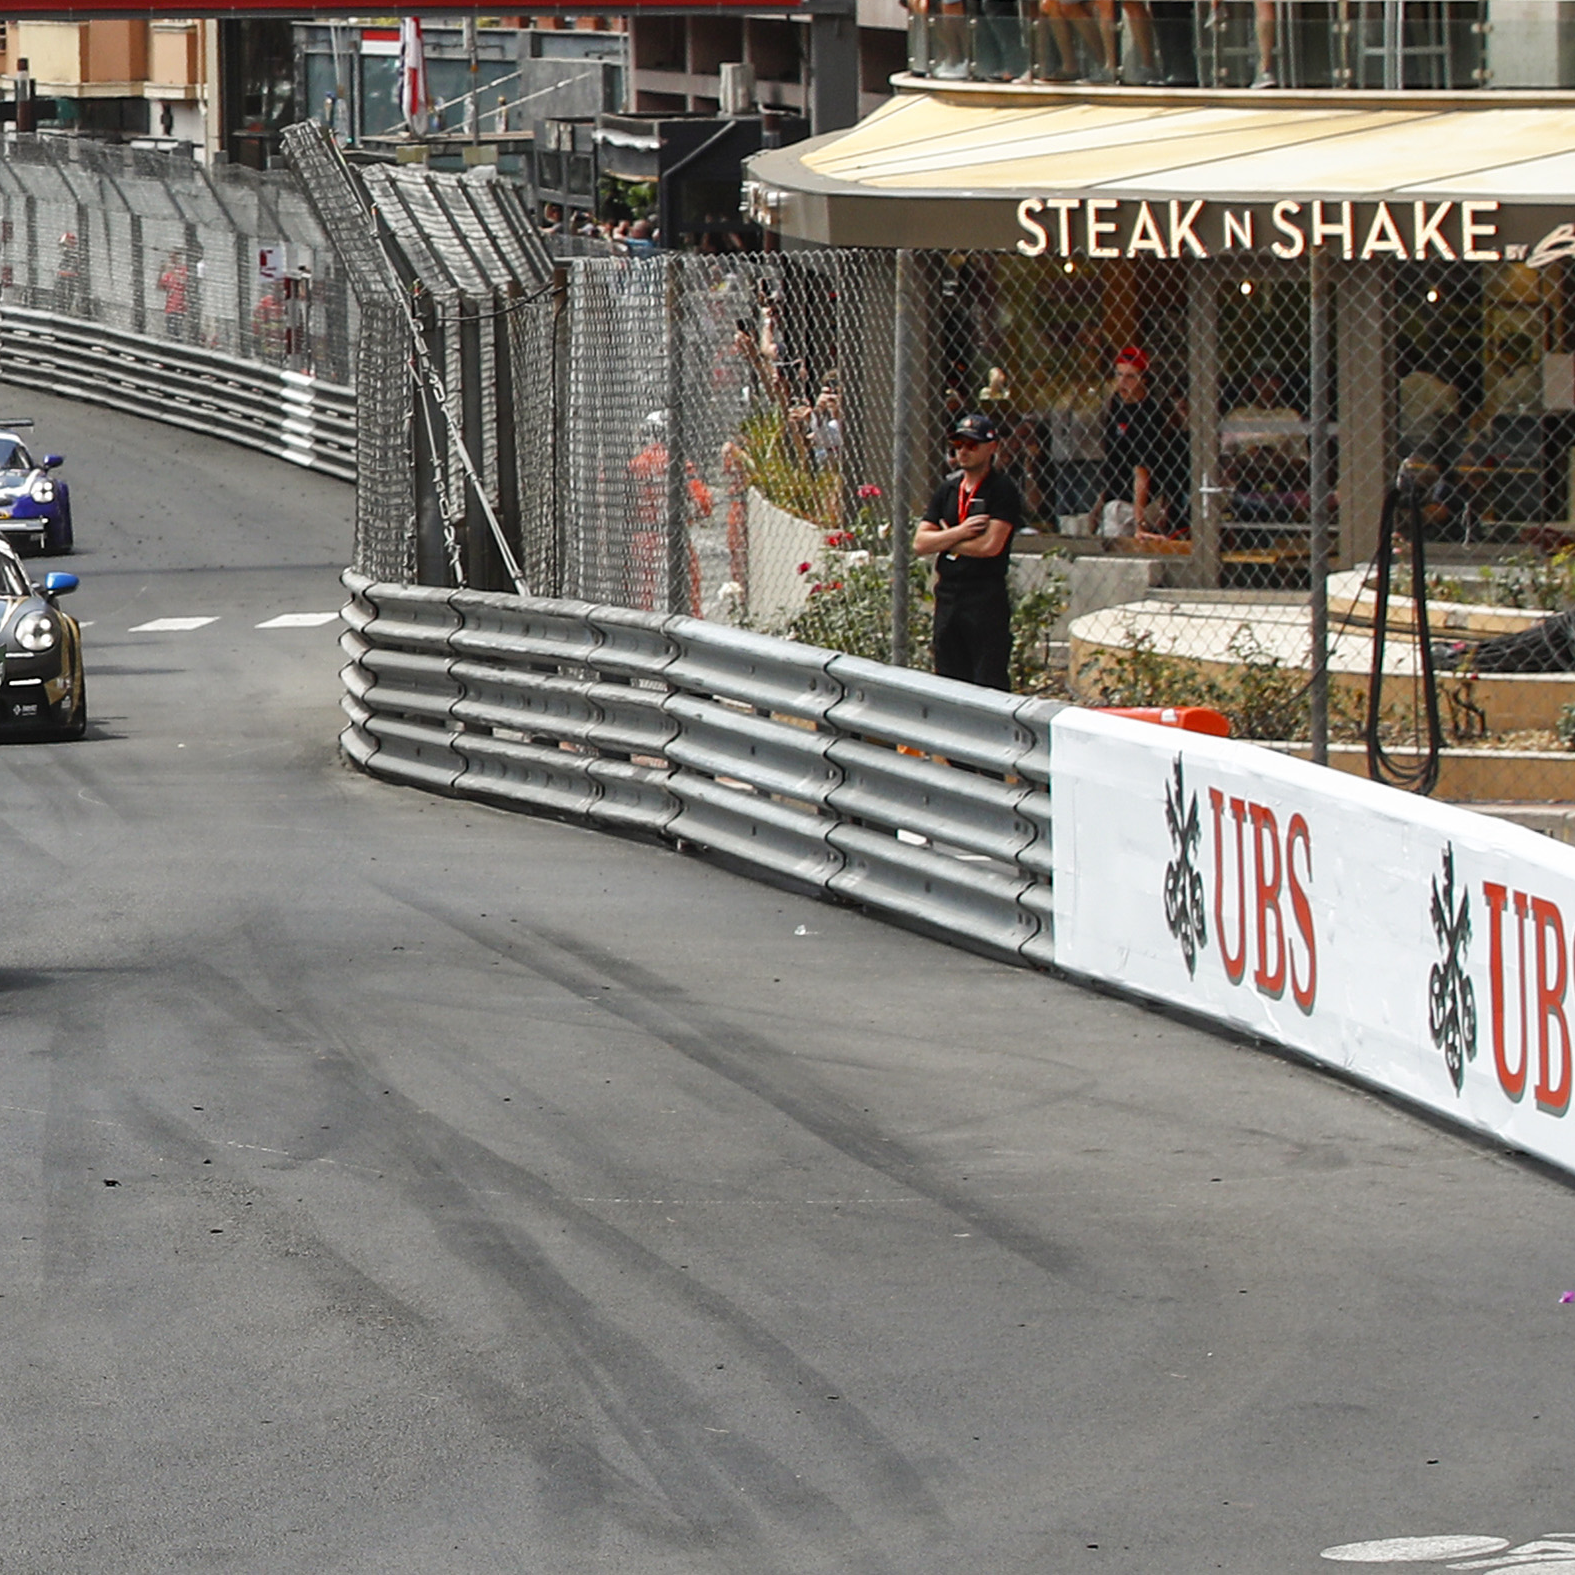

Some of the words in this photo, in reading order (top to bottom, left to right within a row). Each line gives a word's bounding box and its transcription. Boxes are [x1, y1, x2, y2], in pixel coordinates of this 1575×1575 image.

[1016, 198, 1207, 259] STEAK
[1270, 199, 1501, 262] SHAKE
[1208, 786, 1316, 1017] UBS
[1482, 881, 1575, 1118] UB
